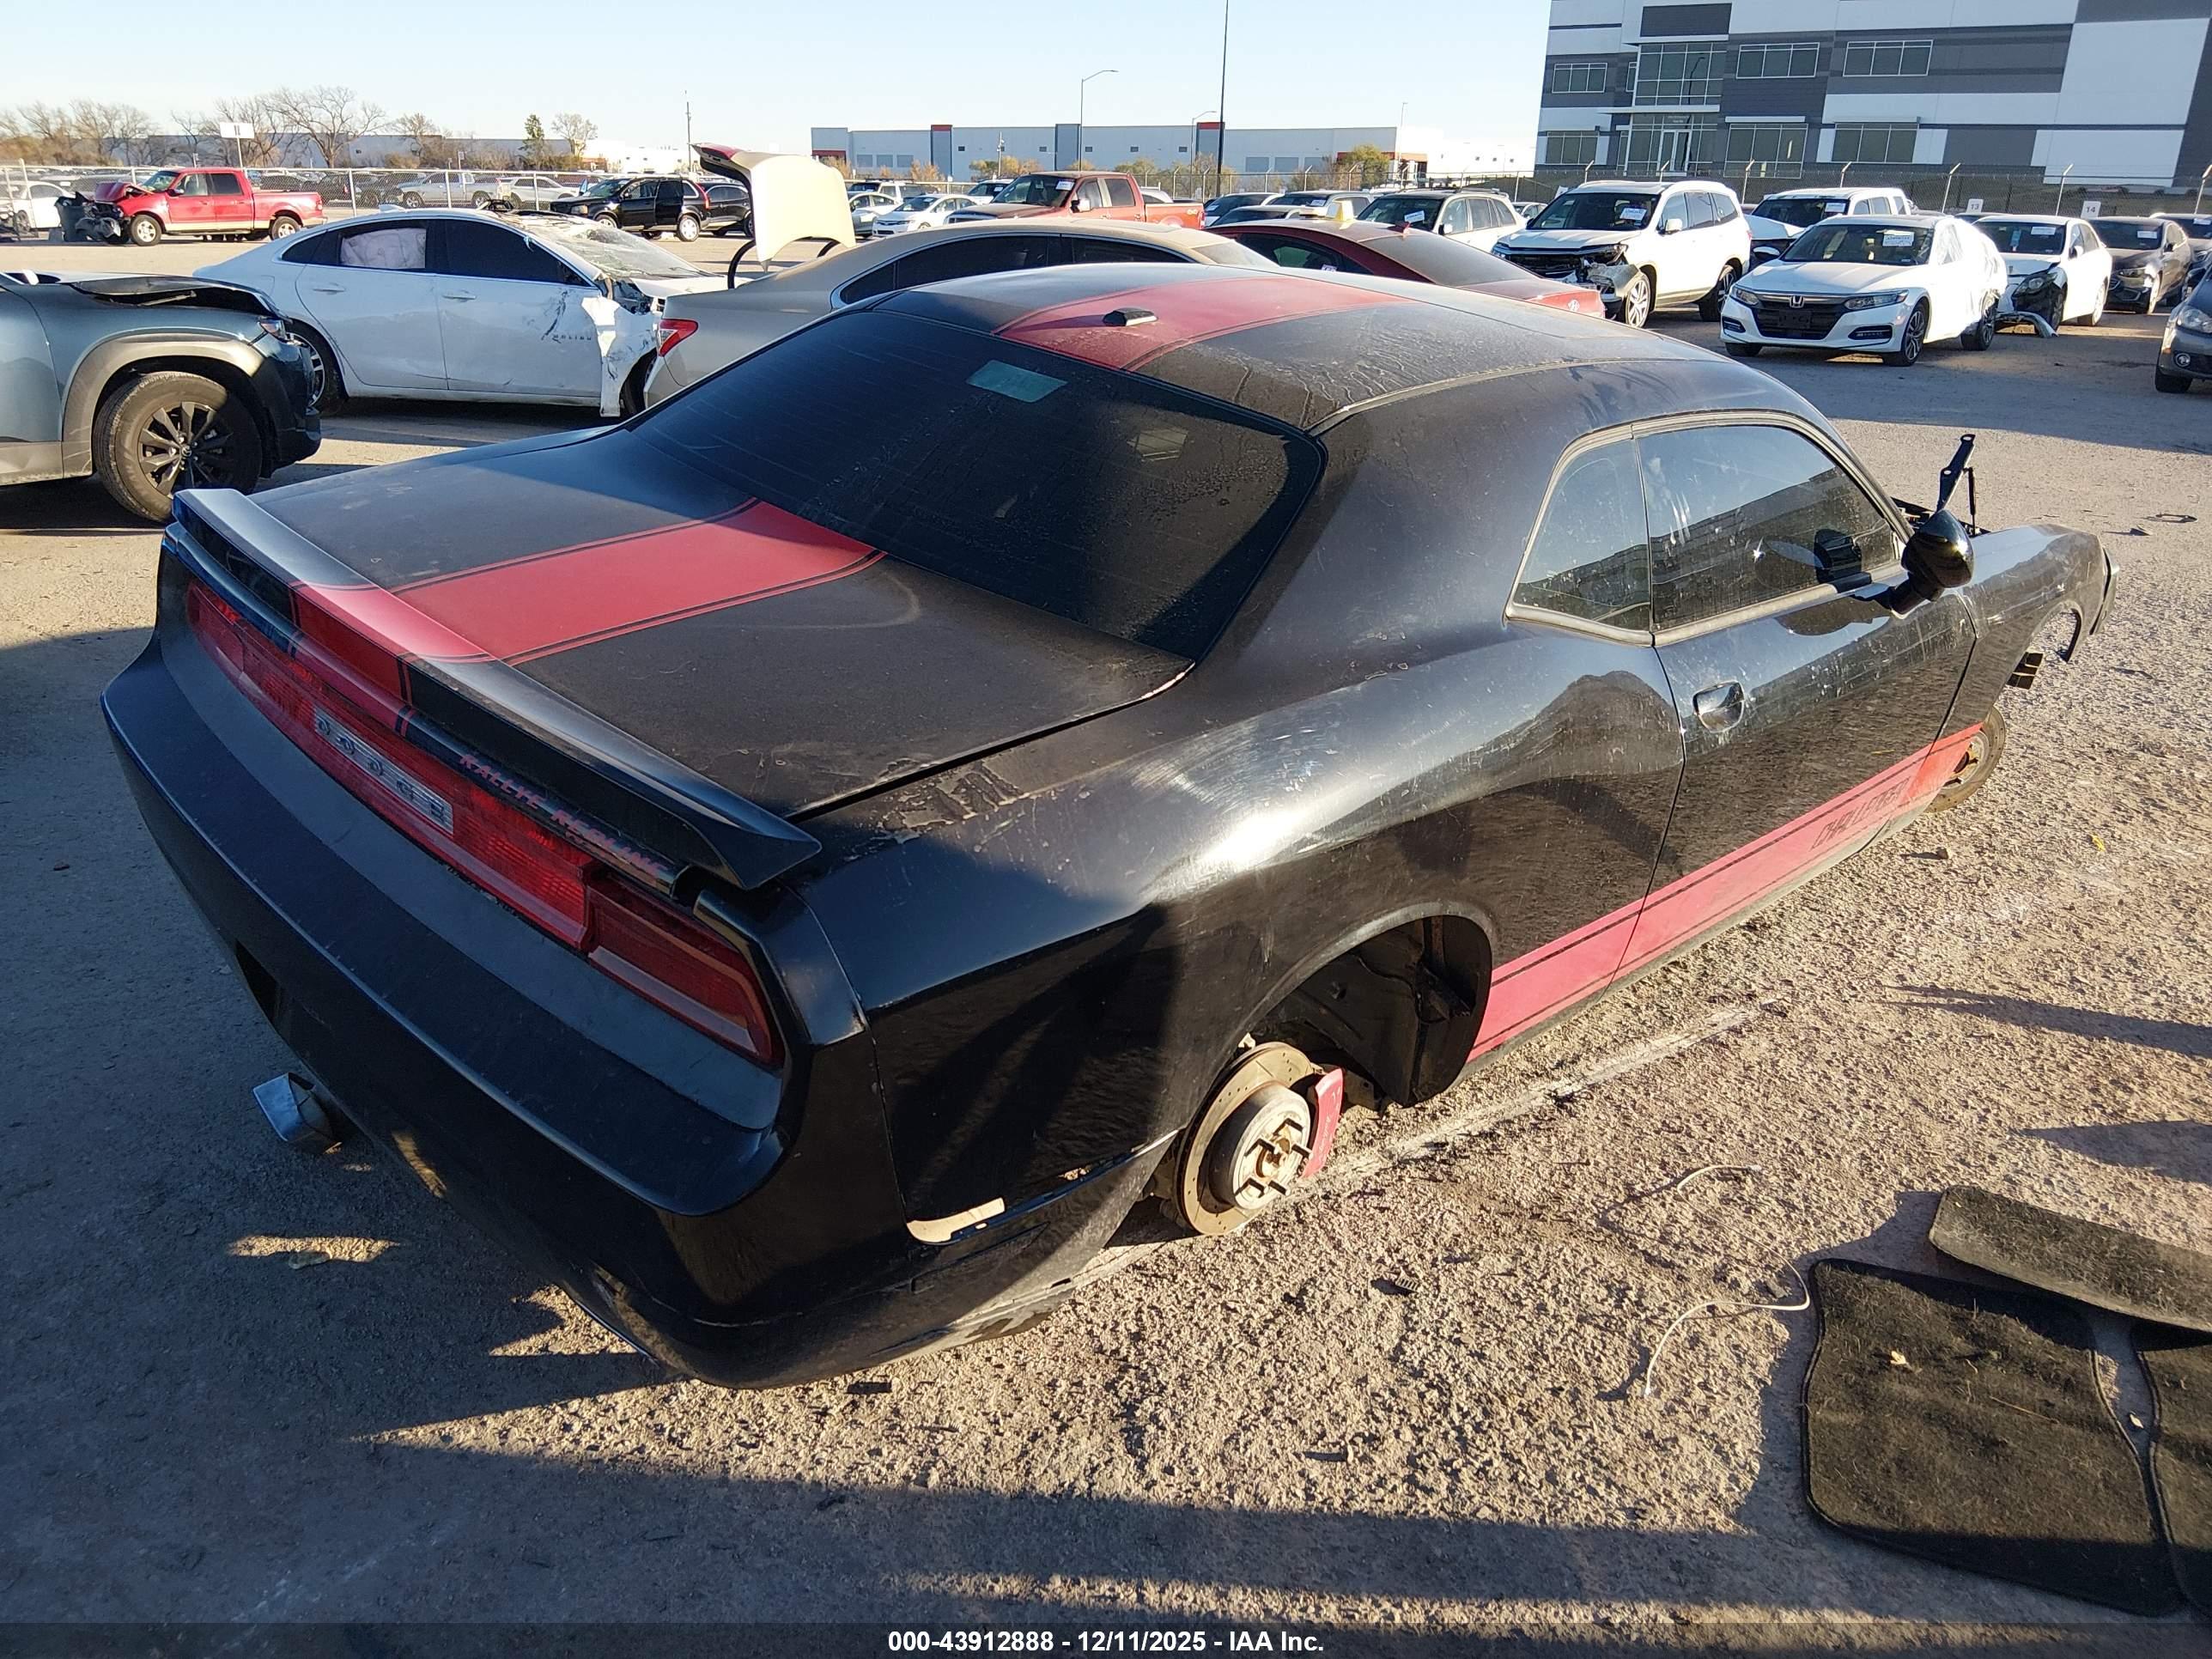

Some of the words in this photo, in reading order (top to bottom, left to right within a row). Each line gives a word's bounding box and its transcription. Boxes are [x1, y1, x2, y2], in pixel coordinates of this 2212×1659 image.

[316, 714, 446, 824] DODGE
[459, 754, 545, 811] RALLYE
[550, 809, 669, 878] REDLINE
